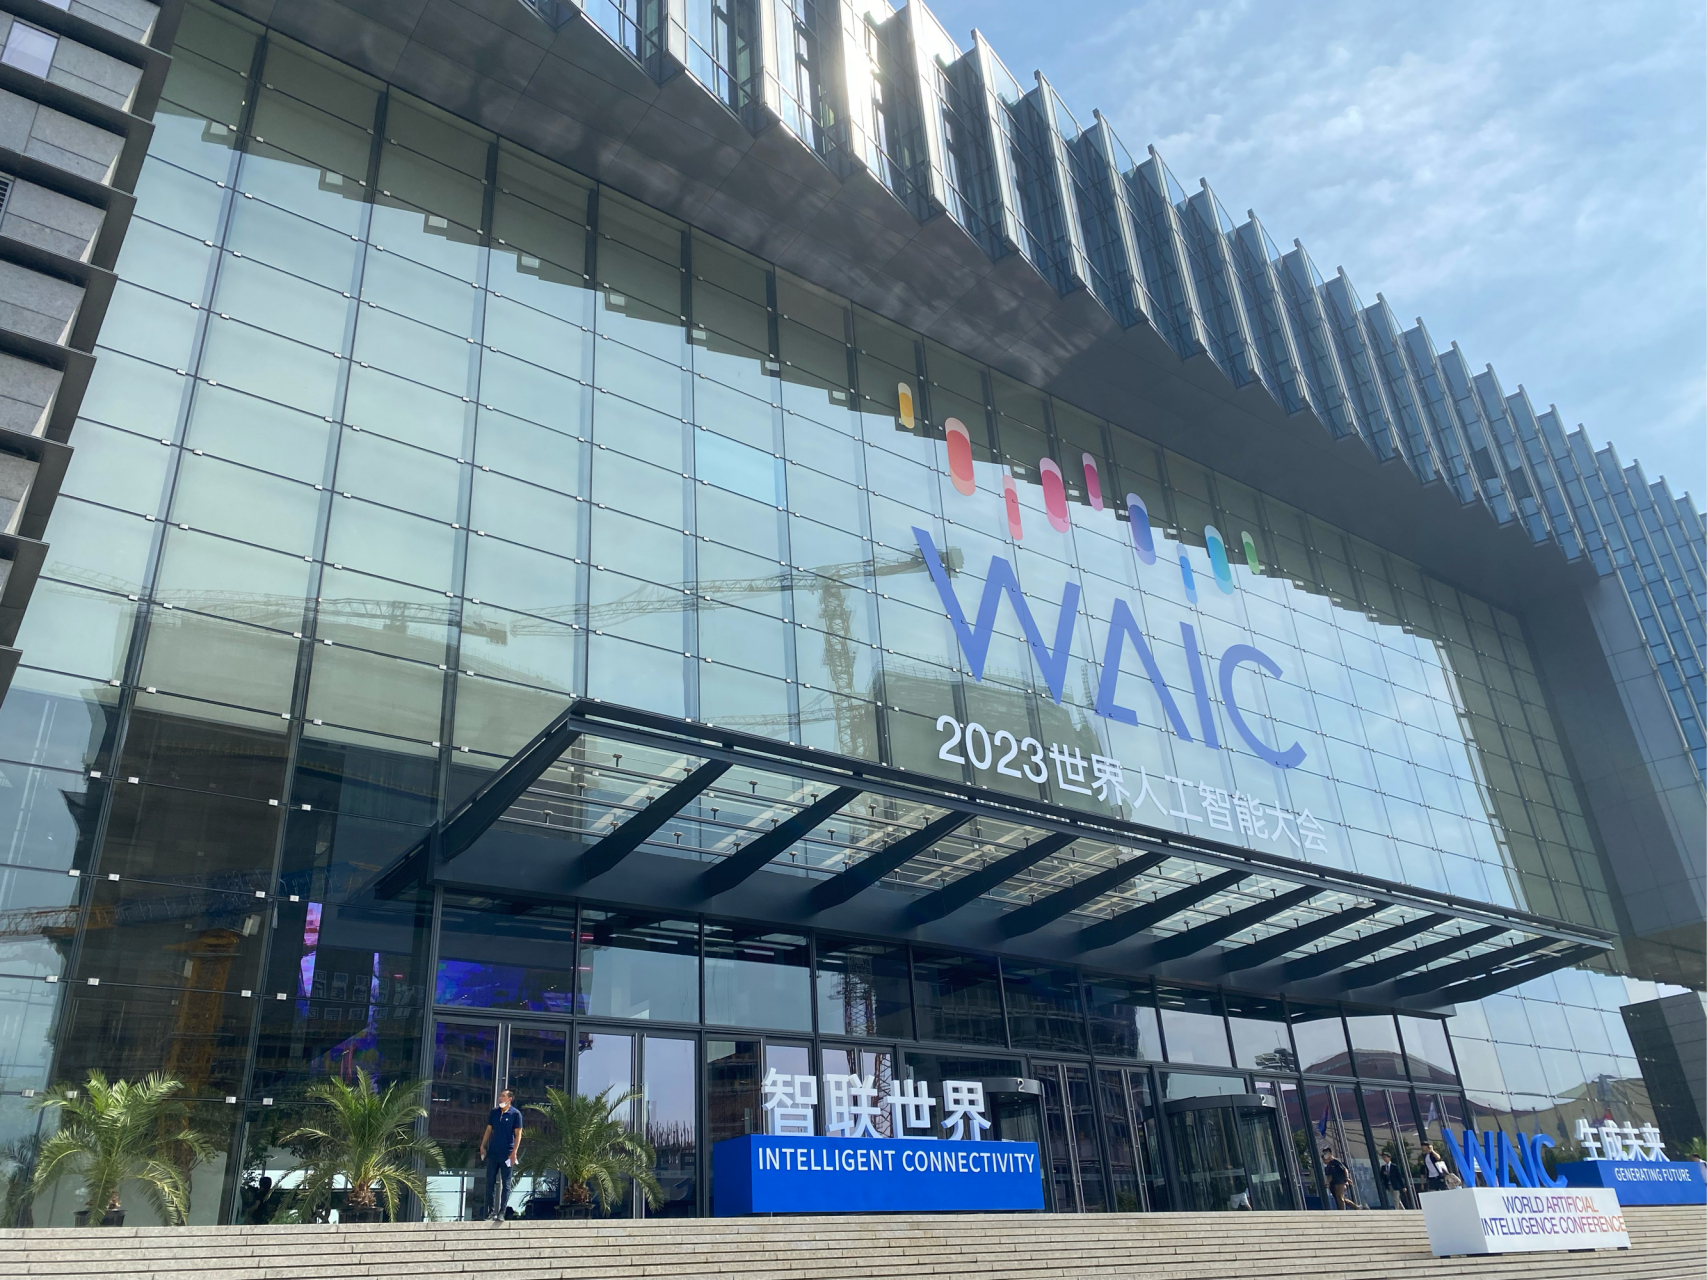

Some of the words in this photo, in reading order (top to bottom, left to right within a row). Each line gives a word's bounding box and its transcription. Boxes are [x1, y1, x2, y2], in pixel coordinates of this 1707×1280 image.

[911, 526, 1307, 769] WAIC
[936, 715, 1328, 854] 2023世界人工智能大会
[1016, 1078, 1025, 1092] 2
[762, 1067, 991, 1142] 智联世界
[1260, 1094, 1268, 1106] 2
[1574, 1118, 1670, 1162] 生成未来
[758, 1147, 896, 1172] INTELLIGENT
[902, 1150, 1035, 1173] CONNECTIVITY
[1441, 1129, 1568, 1188] WAIC
[1614, 1167, 1662, 1181] GENERATING
[1663, 1168, 1692, 1182] FUTURE
[1502, 1196, 1544, 1214] WORLD
[1546, 1195, 1599, 1213] ARTIFICIAL
[1480, 1217, 1559, 1236] INTELLIGENCE
[1559, 1215, 1627, 1234] CONFERENCE
